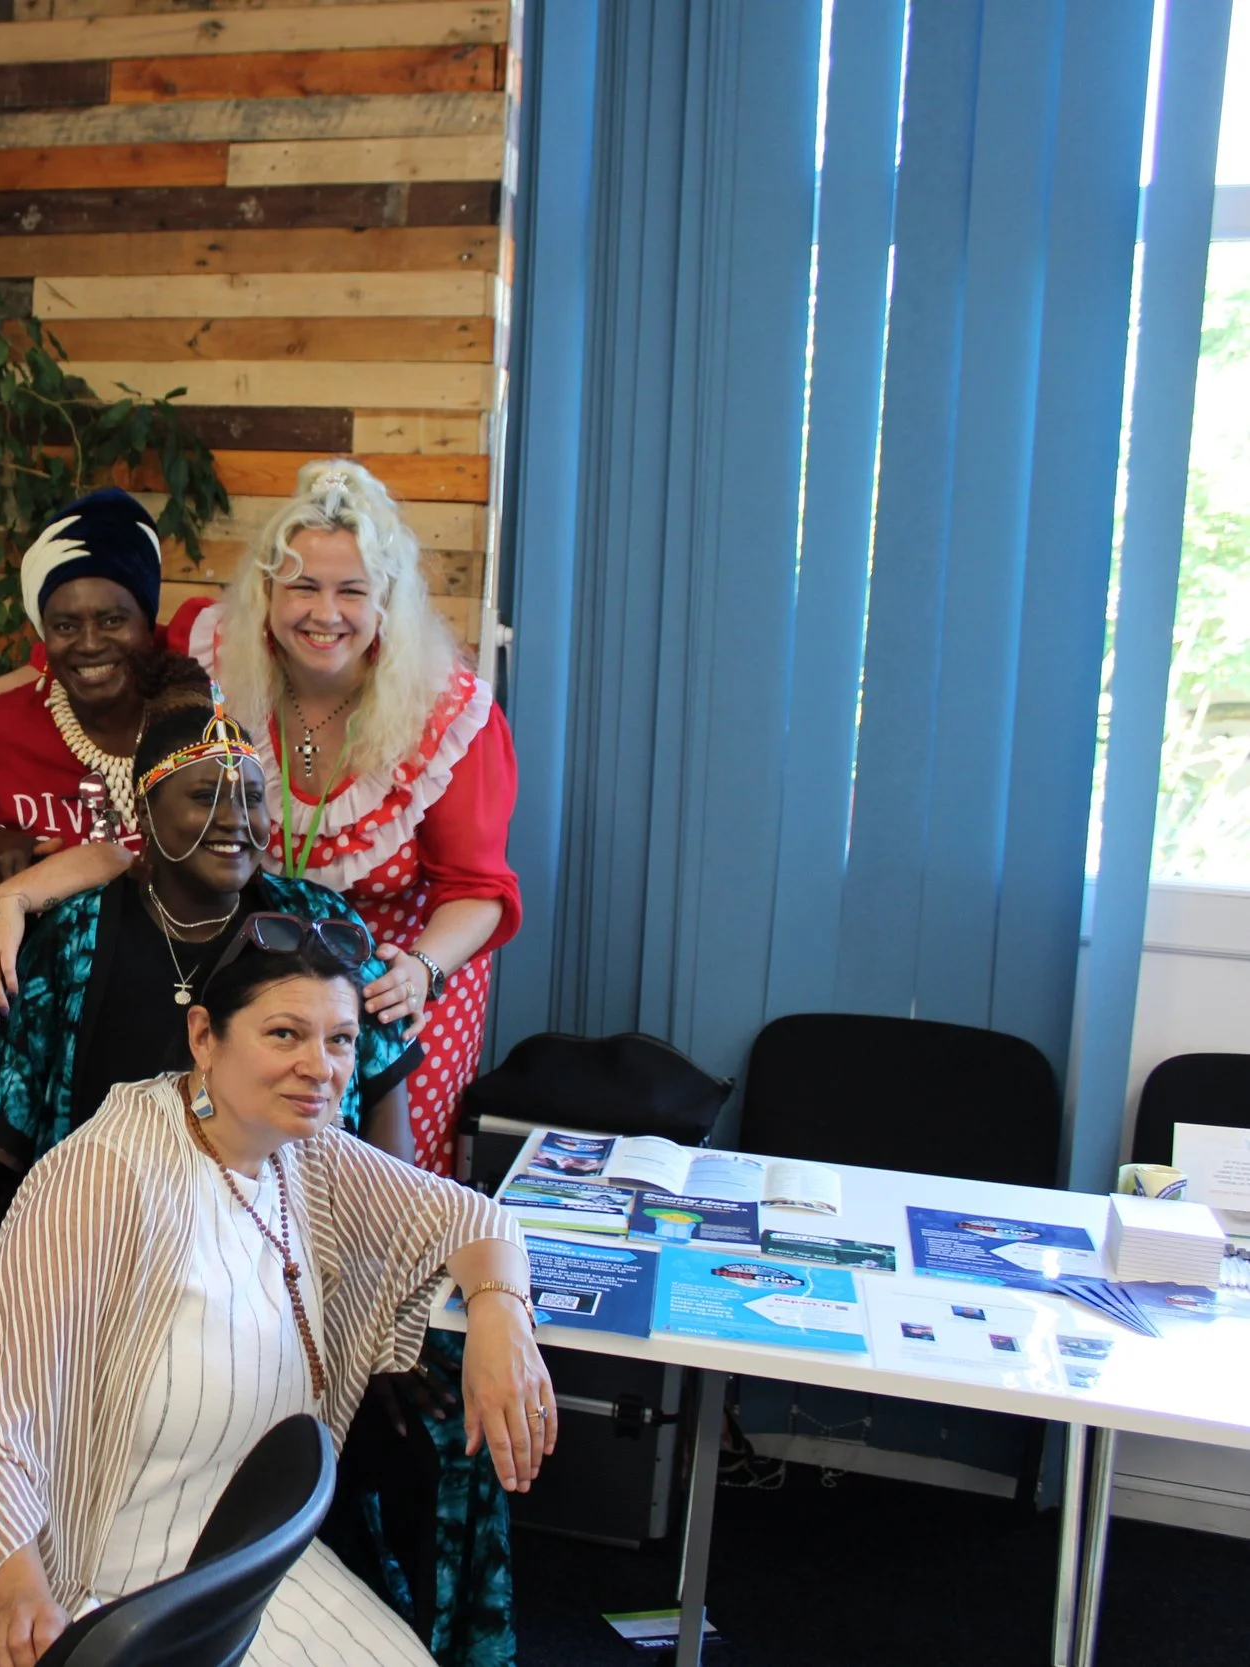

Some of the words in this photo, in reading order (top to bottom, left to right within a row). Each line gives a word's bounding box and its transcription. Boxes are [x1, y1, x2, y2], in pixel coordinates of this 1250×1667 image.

[643, 1192, 699, 1203] County
[701, 1199, 738, 1207] lines
[714, 1268, 754, 1279] Hate
[755, 1273, 802, 1285] crime
